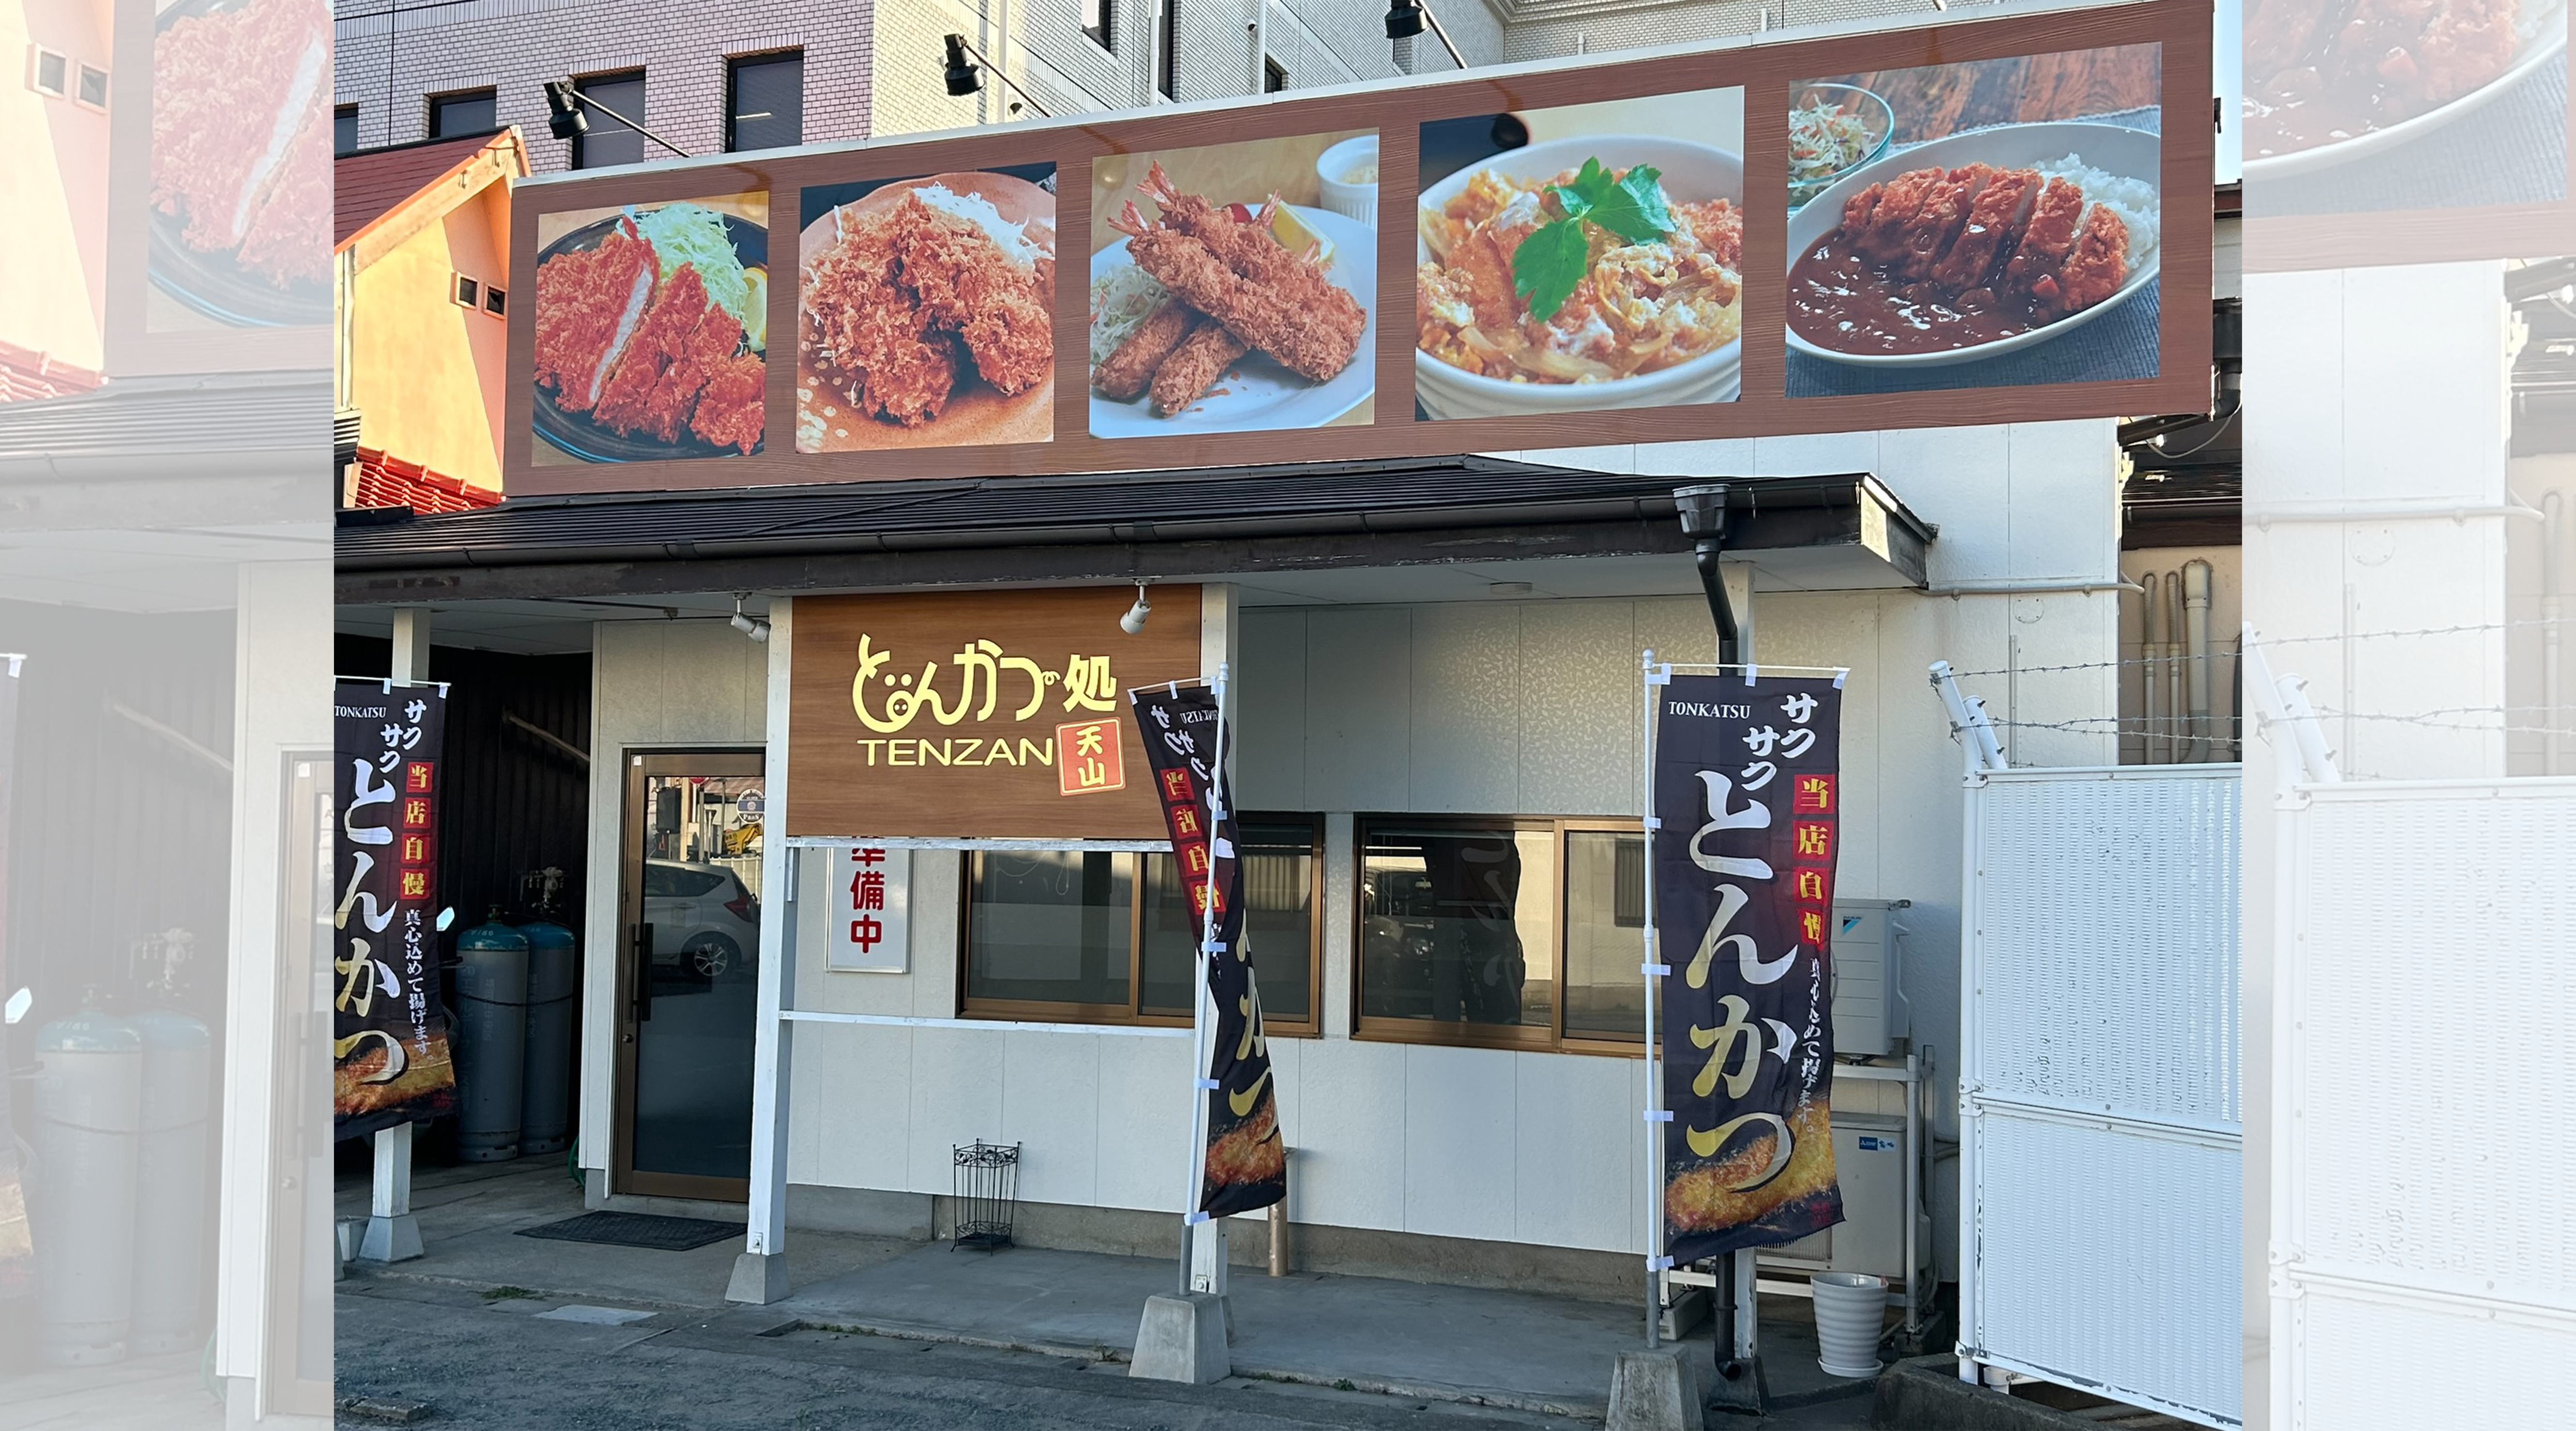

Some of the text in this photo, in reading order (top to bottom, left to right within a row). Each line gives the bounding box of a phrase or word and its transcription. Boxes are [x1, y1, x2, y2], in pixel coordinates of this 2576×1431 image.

[334, 705, 386, 718] TONKATSU
[857, 738, 1053, 767] TENZAN
[1076, 725, 1106, 787] 天山
[1669, 701, 1751, 719] TONKATSU
[402, 765, 428, 896] 当店自慢
[334, 758, 405, 1083] とんかつ
[404, 909, 434, 1060] 真心込めて揚げます。
[1687, 770, 1798, 1191] とんかつ
